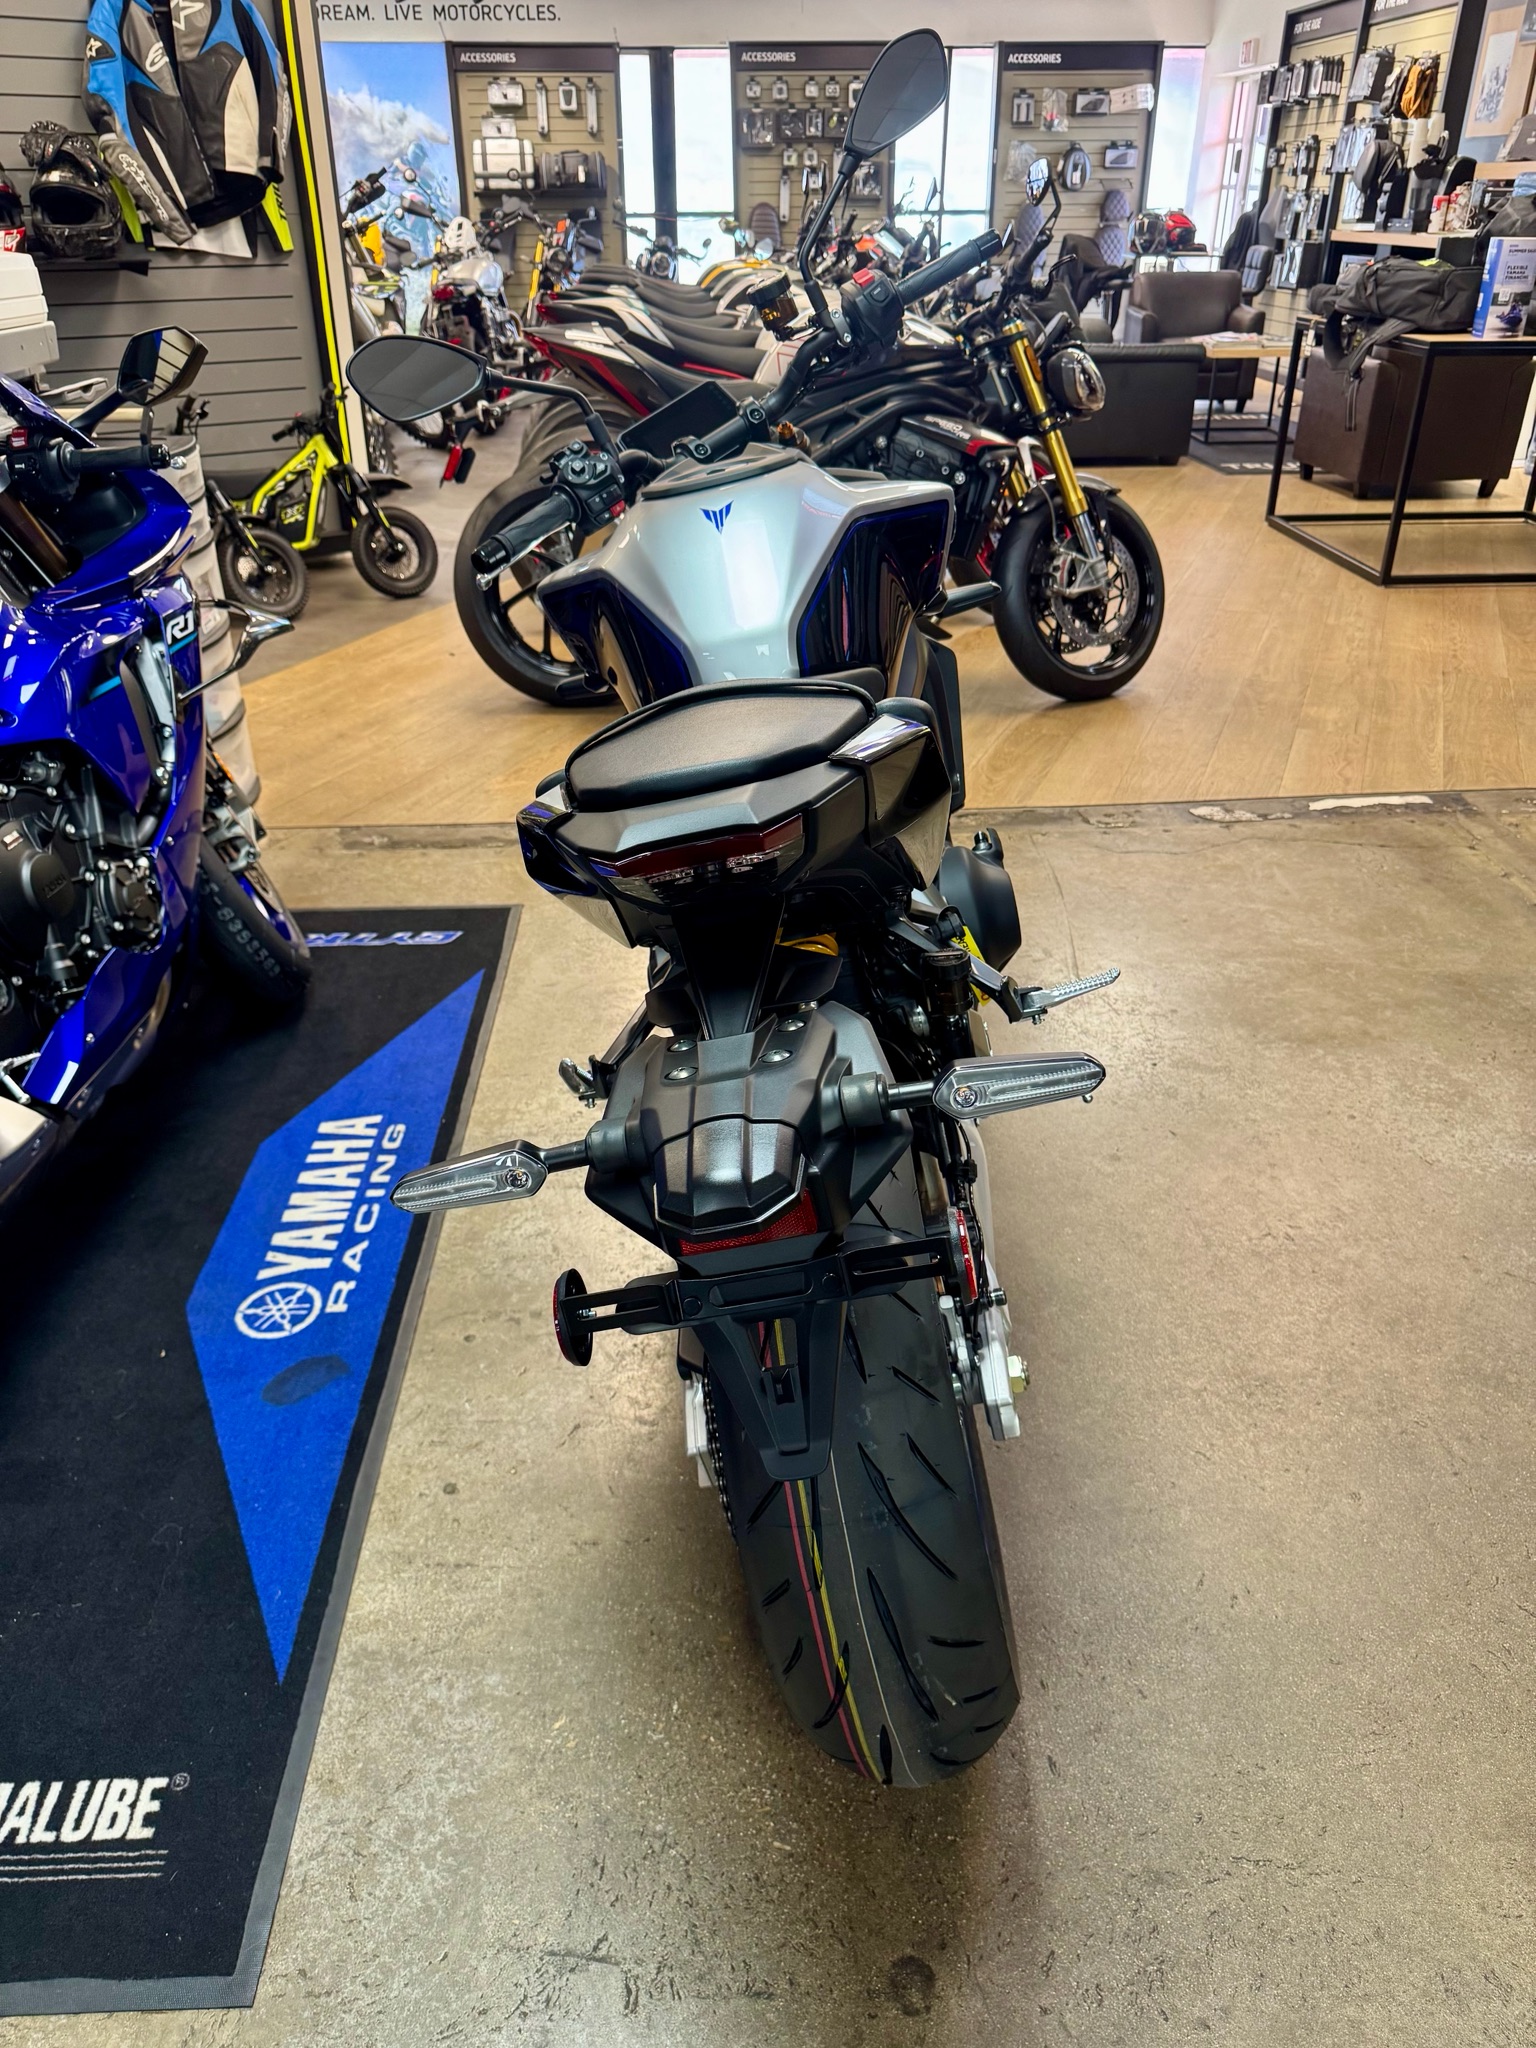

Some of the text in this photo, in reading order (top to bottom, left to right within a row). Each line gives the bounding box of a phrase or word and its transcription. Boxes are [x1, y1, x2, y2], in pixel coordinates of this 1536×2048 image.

[384, 4, 423, 22] LIVE
[433, 4, 561, 22] MOTORCYCLES.
[459, 52, 517, 64] ACCESSORIES
[741, 51, 796, 63] ACCESSORIES
[1007, 53, 1062, 65] ACCESSORIES
[256, 1113, 385, 1281] YAMAHA
[323, 1122, 408, 1314] RACING
[0, 1776, 169, 1845] ALUBE
